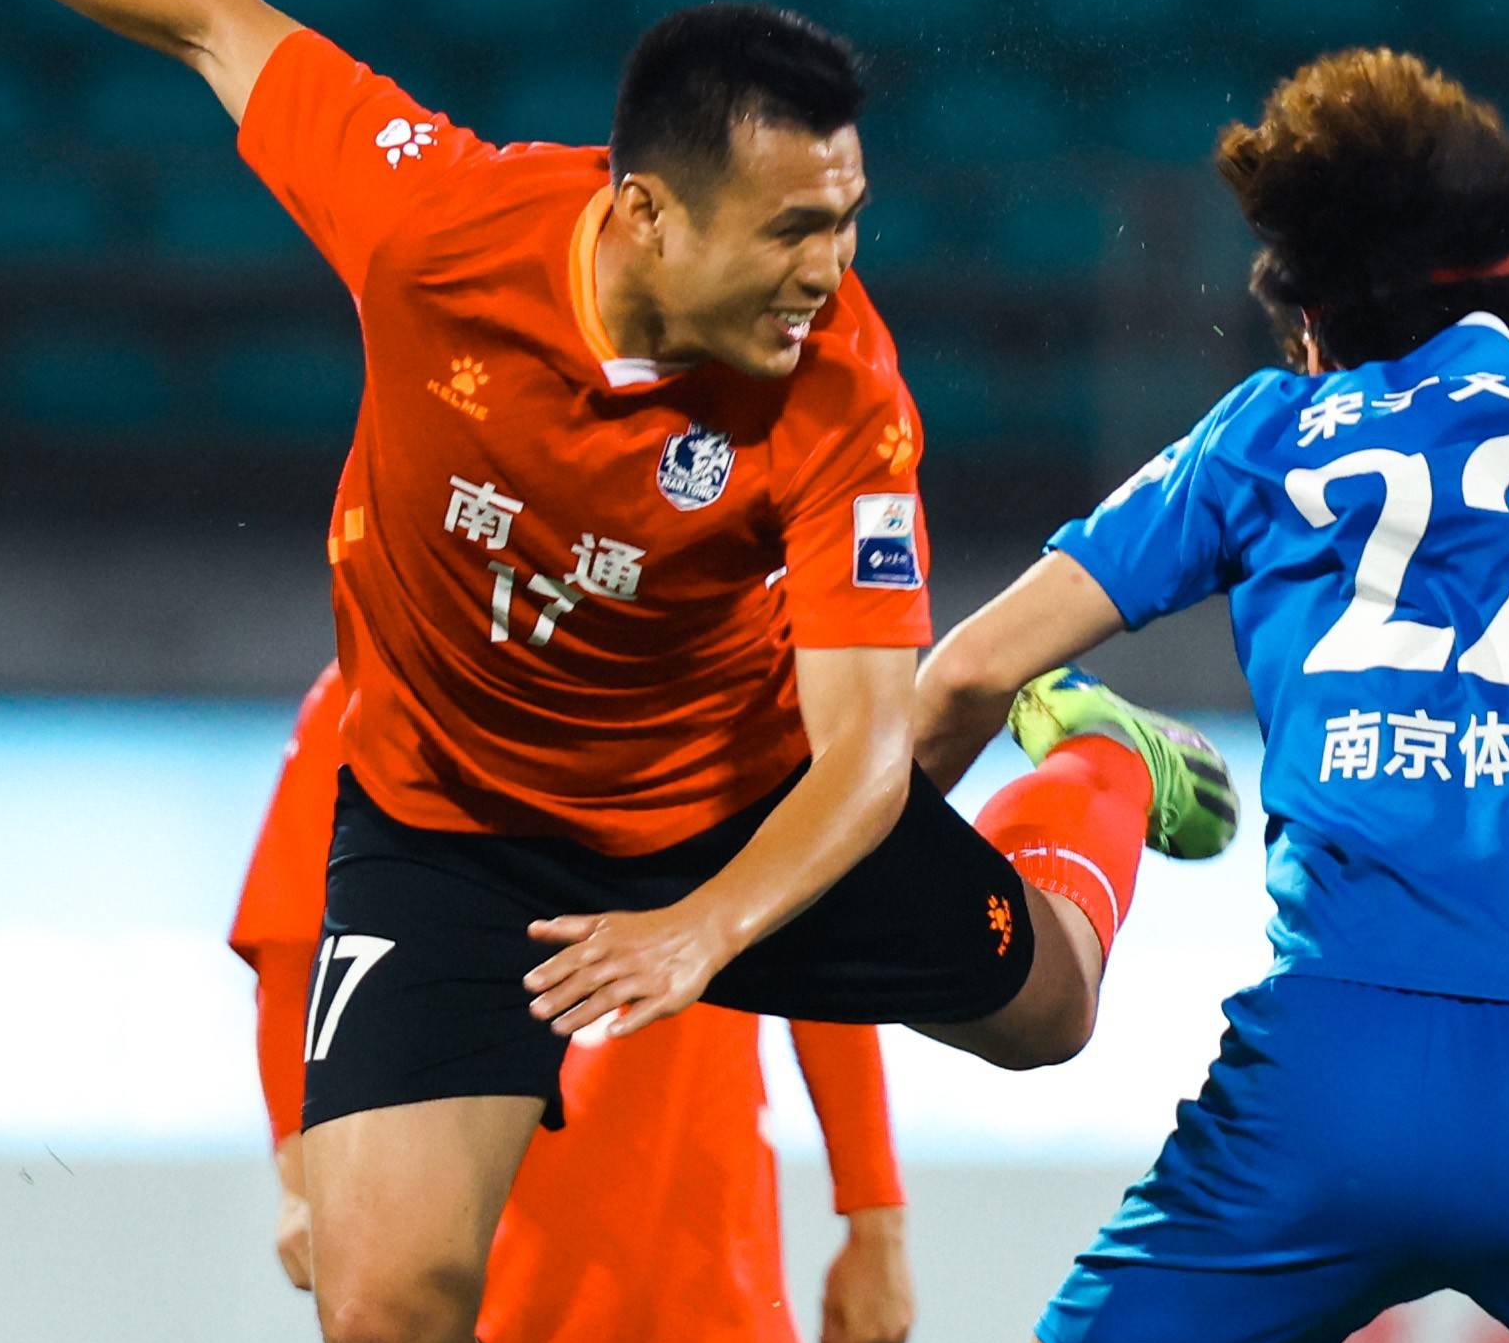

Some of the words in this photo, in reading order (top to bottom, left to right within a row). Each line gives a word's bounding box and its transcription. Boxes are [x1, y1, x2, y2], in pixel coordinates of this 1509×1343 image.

[444, 474, 647, 602] 南通
[487, 560, 586, 646] 17
[304, 934, 396, 1063] 17
